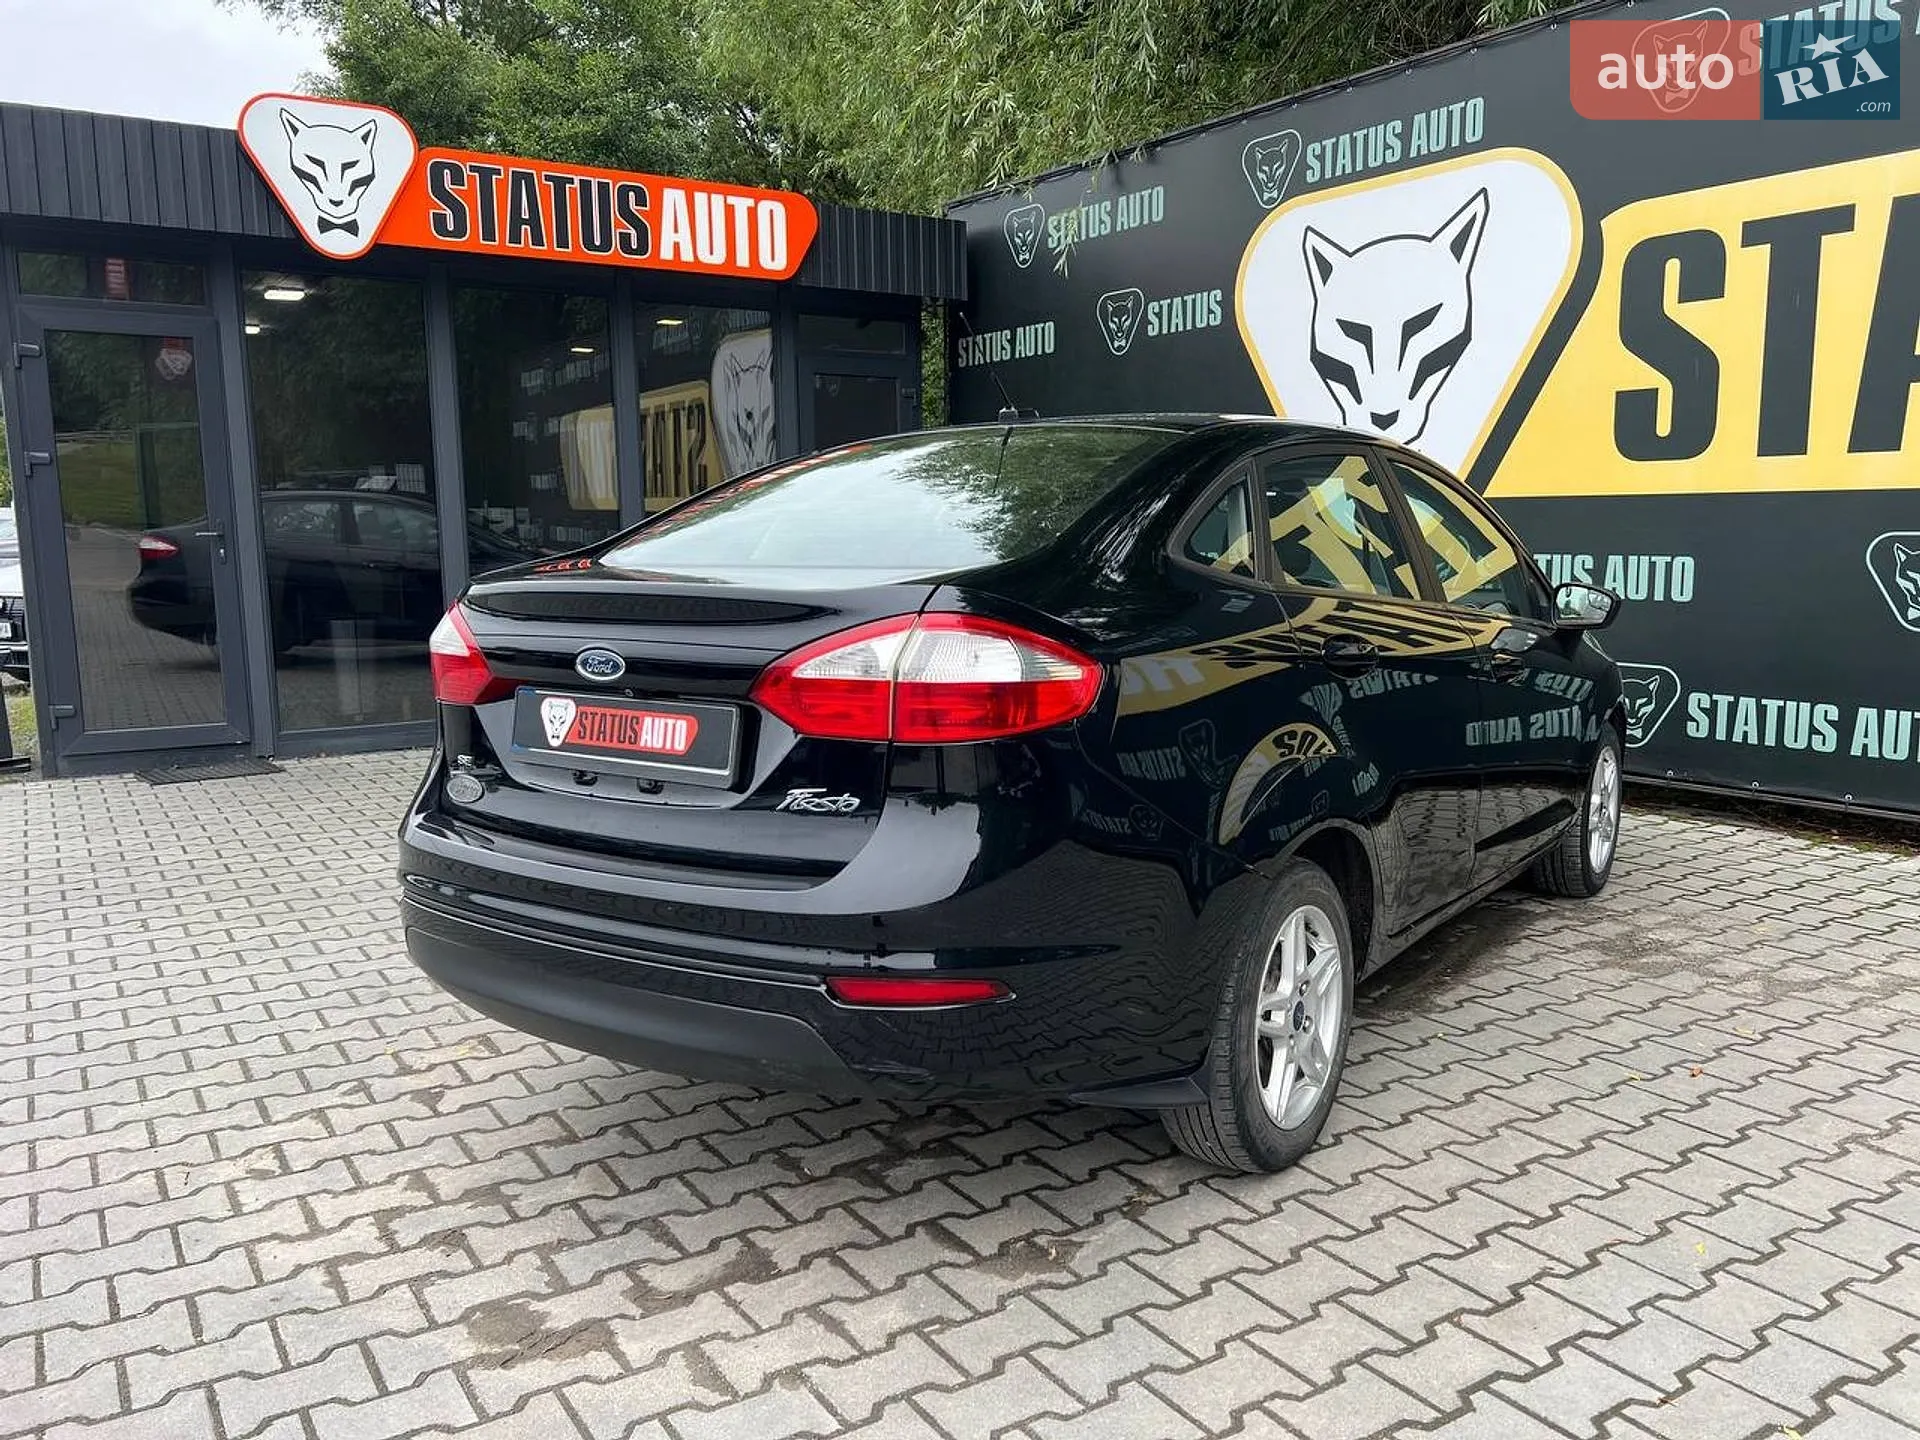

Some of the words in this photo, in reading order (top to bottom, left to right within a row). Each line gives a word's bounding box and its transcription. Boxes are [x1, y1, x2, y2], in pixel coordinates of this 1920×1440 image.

[1306, 120, 1402, 184] STATUS
[1409, 97, 1485, 158] AUTO
[427, 158, 650, 259] STATUS
[659, 188, 788, 271] AUTO
[1116, 186, 1164, 232] AUTO
[1147, 290, 1222, 337] STATUS
[957, 329, 1011, 368] STATUS
[1015, 321, 1055, 358] AUTO
[1604, 554, 1695, 602] AUTO
[586, 655, 614, 673] Ford
[578, 711, 639, 745] STATUS
[640, 716, 688, 752] AUTO
[1687, 692, 1839, 753] STATUS
[1849, 707, 1920, 763] AU
[776, 788, 860, 812] Fiesta
